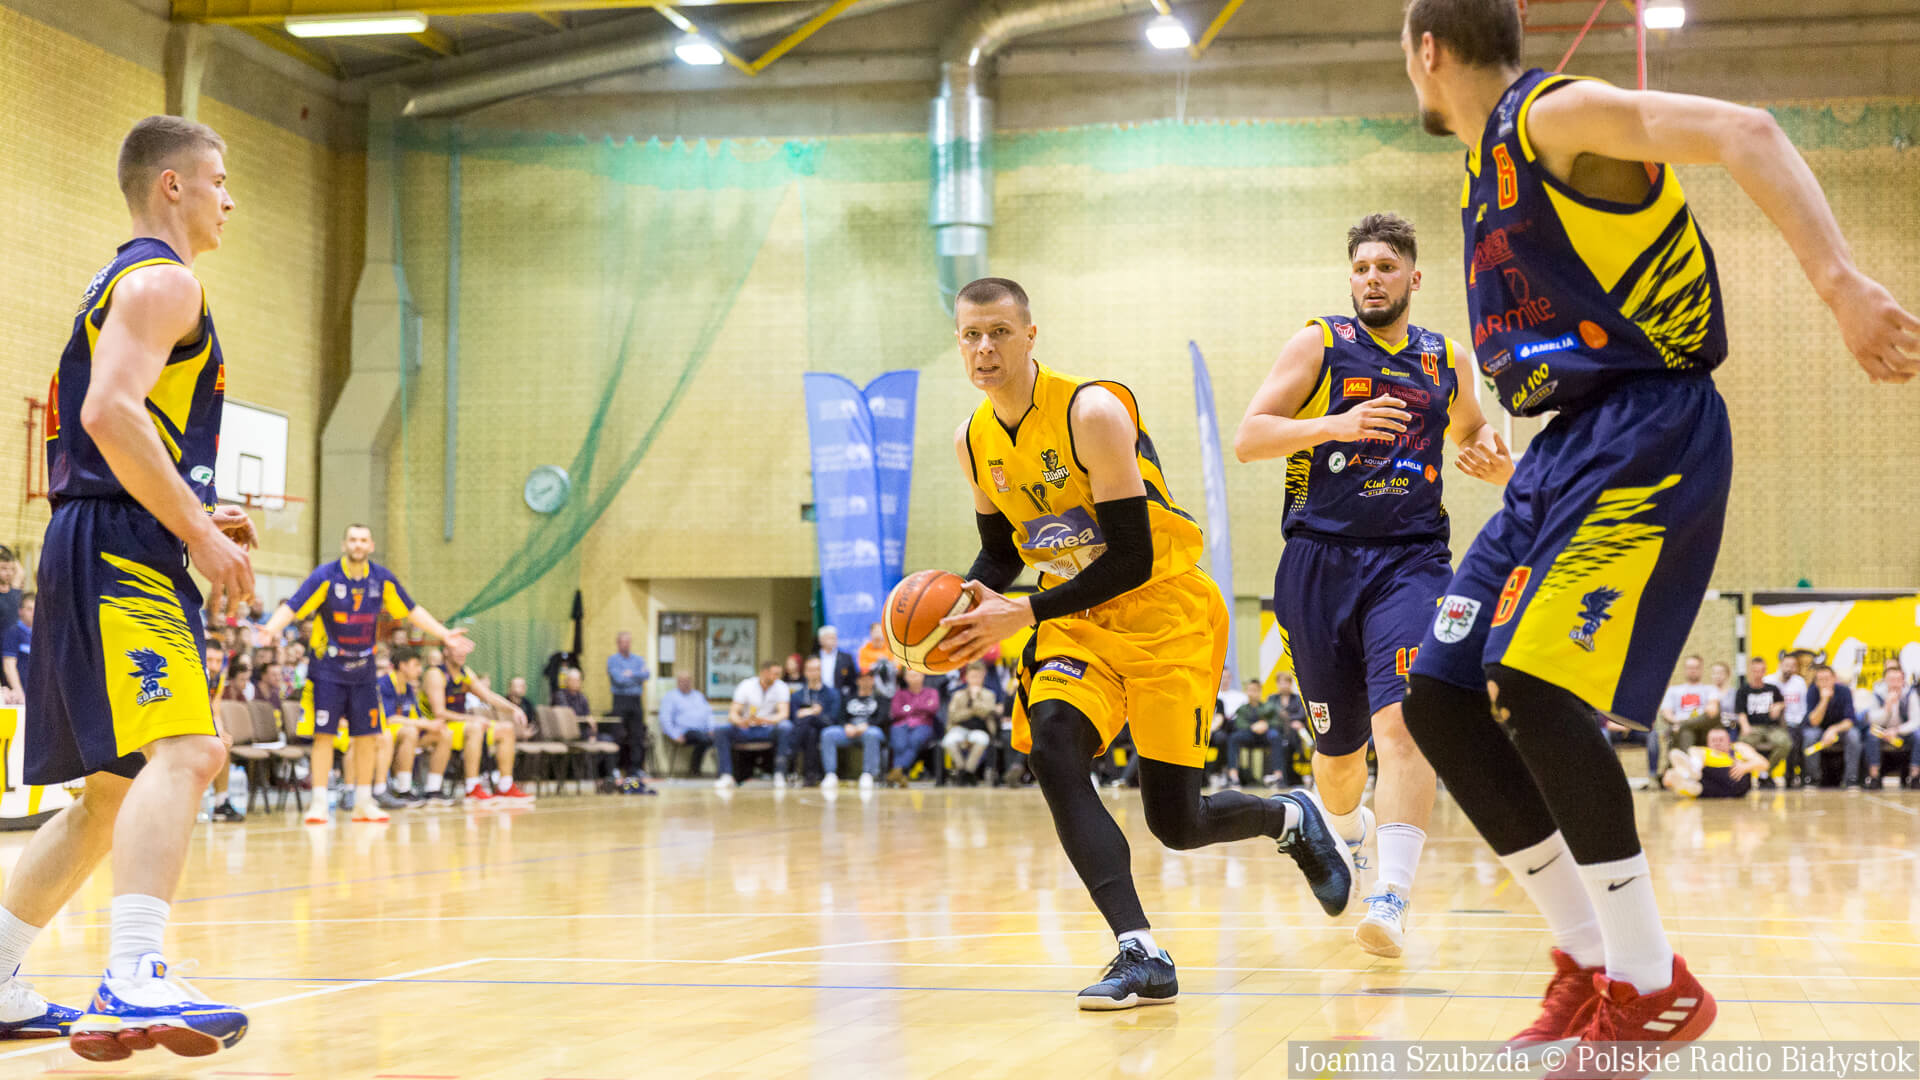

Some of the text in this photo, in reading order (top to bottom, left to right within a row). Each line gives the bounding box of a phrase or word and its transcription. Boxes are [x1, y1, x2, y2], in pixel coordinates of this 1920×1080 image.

[1492, 142, 1519, 211] 8
[1421, 351, 1440, 387] 4
[1527, 362, 1549, 391] 100
[1363, 477, 1409, 490] Klub 100
[1035, 527, 1096, 550] Enea
[1490, 565, 1533, 629] 8
